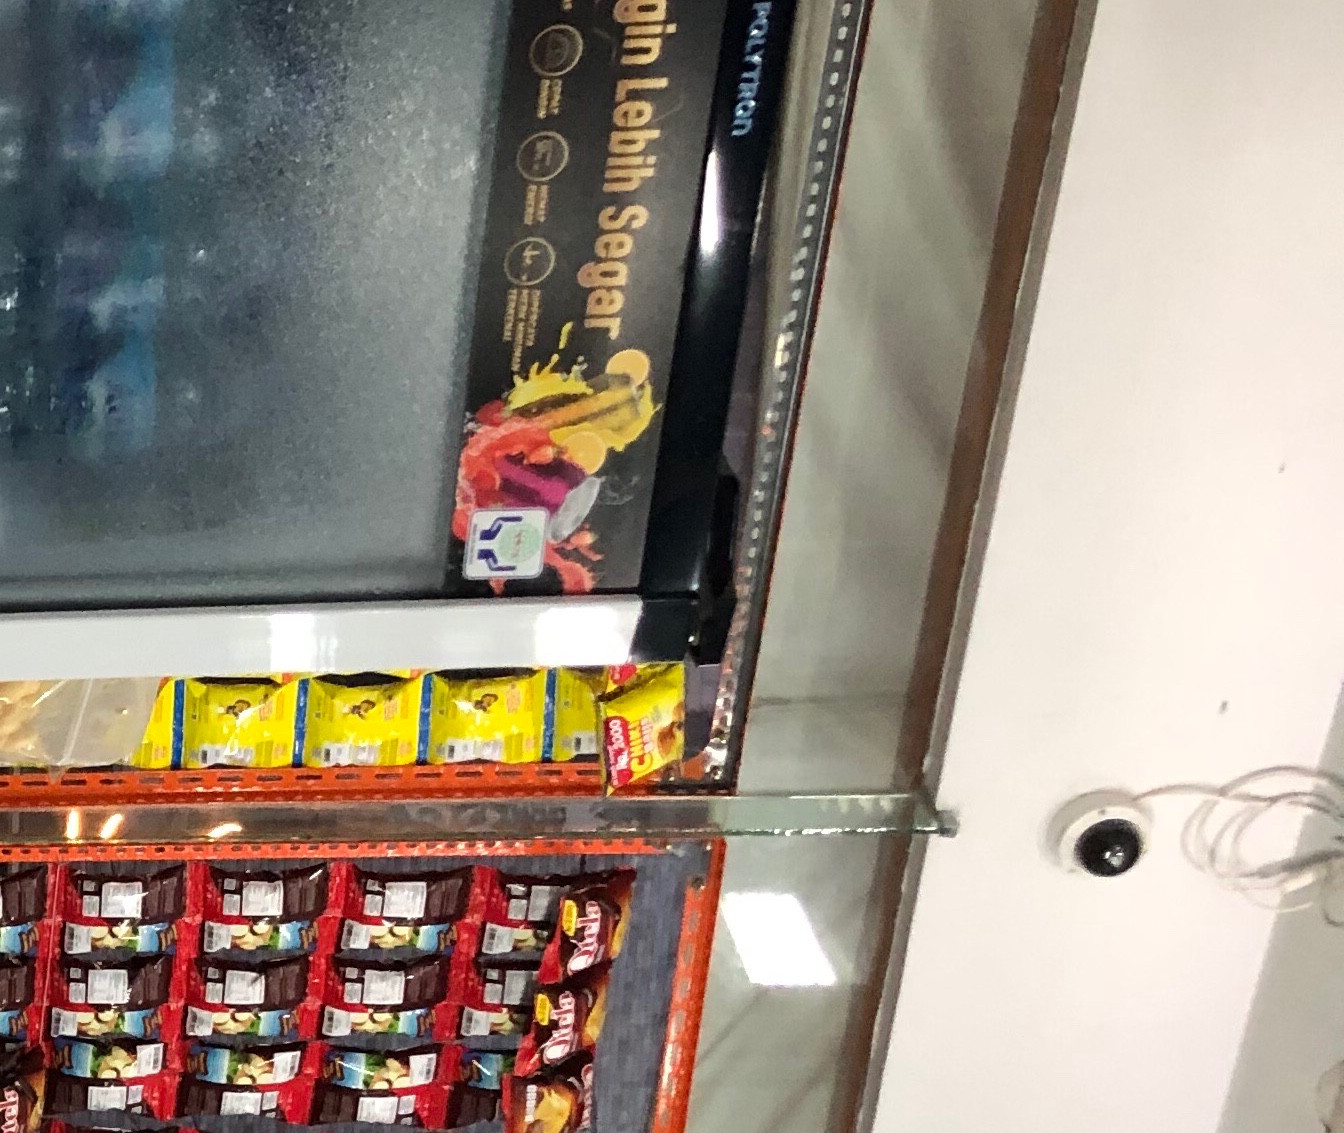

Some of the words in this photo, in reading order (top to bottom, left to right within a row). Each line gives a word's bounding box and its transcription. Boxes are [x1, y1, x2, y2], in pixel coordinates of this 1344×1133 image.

[602, 77, 670, 193] Lebih
[731, 1, 772, 137] POLYTRON
[576, 204, 650, 340] Segar
